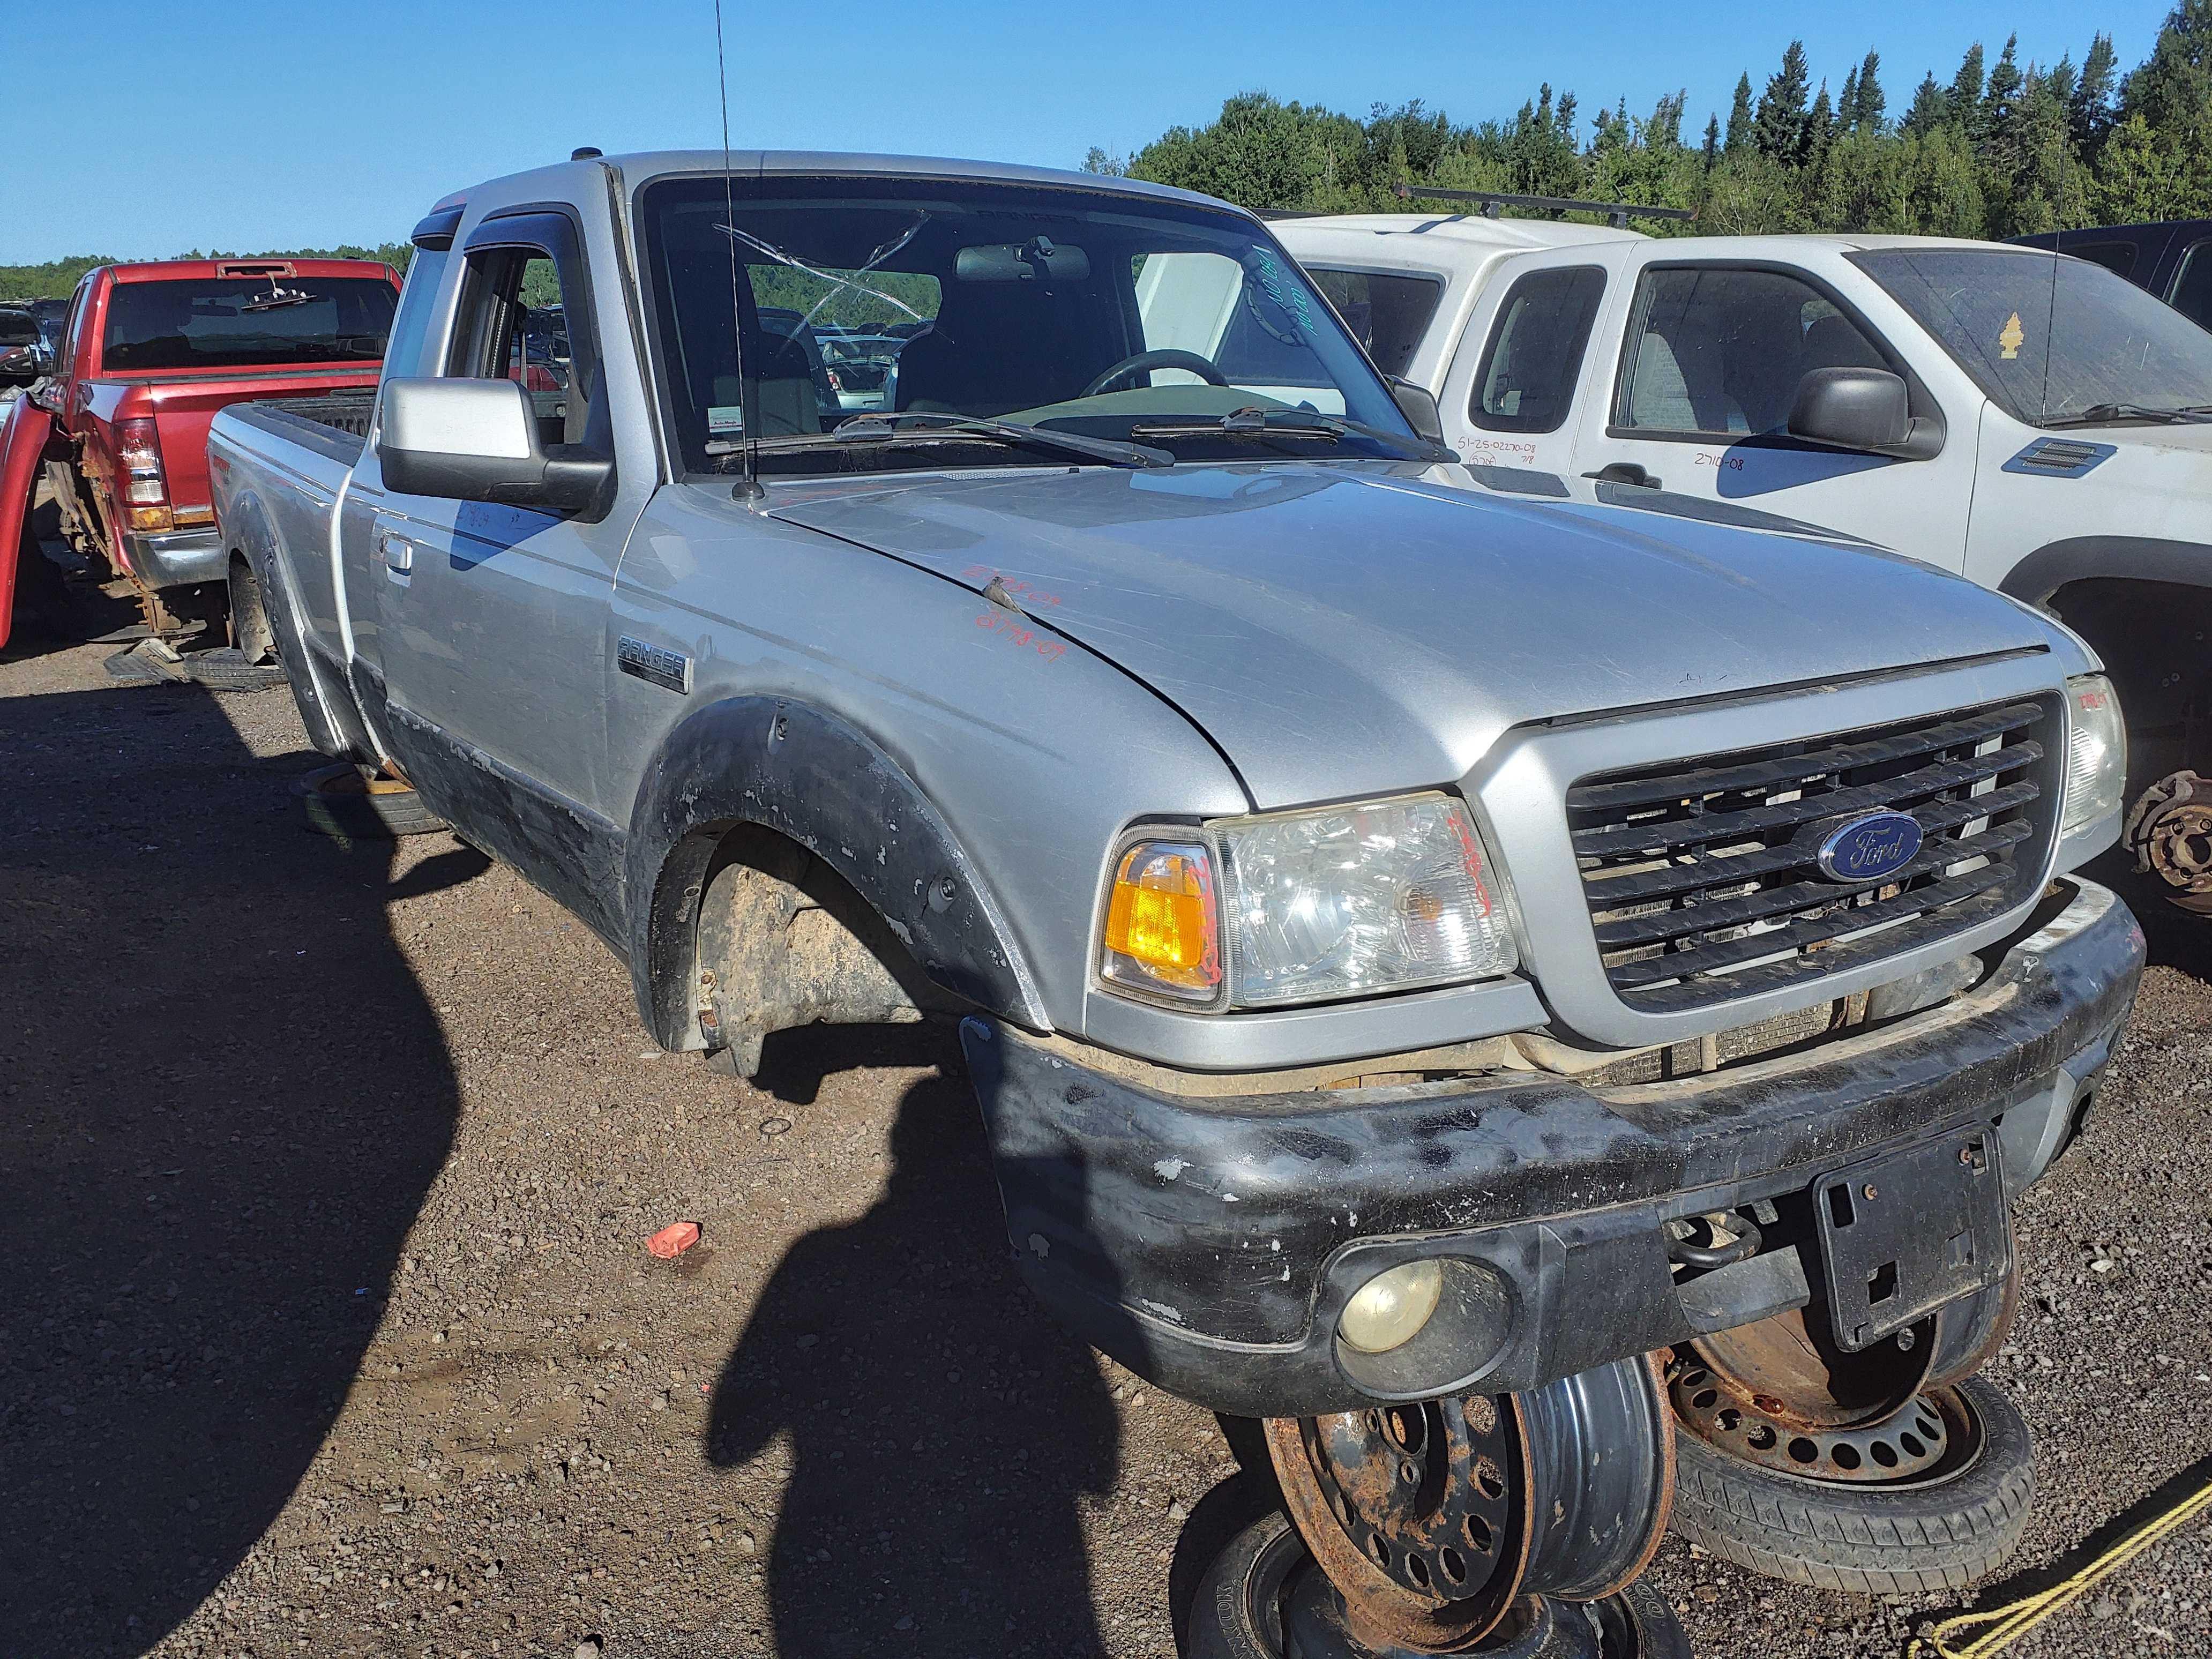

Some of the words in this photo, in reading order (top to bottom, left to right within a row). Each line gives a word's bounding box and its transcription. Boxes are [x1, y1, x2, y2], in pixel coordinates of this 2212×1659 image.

[1694, 452, 1745, 471] 2710-08
[618, 636, 686, 678] RANGER
[1849, 826, 1905, 869] Ford
